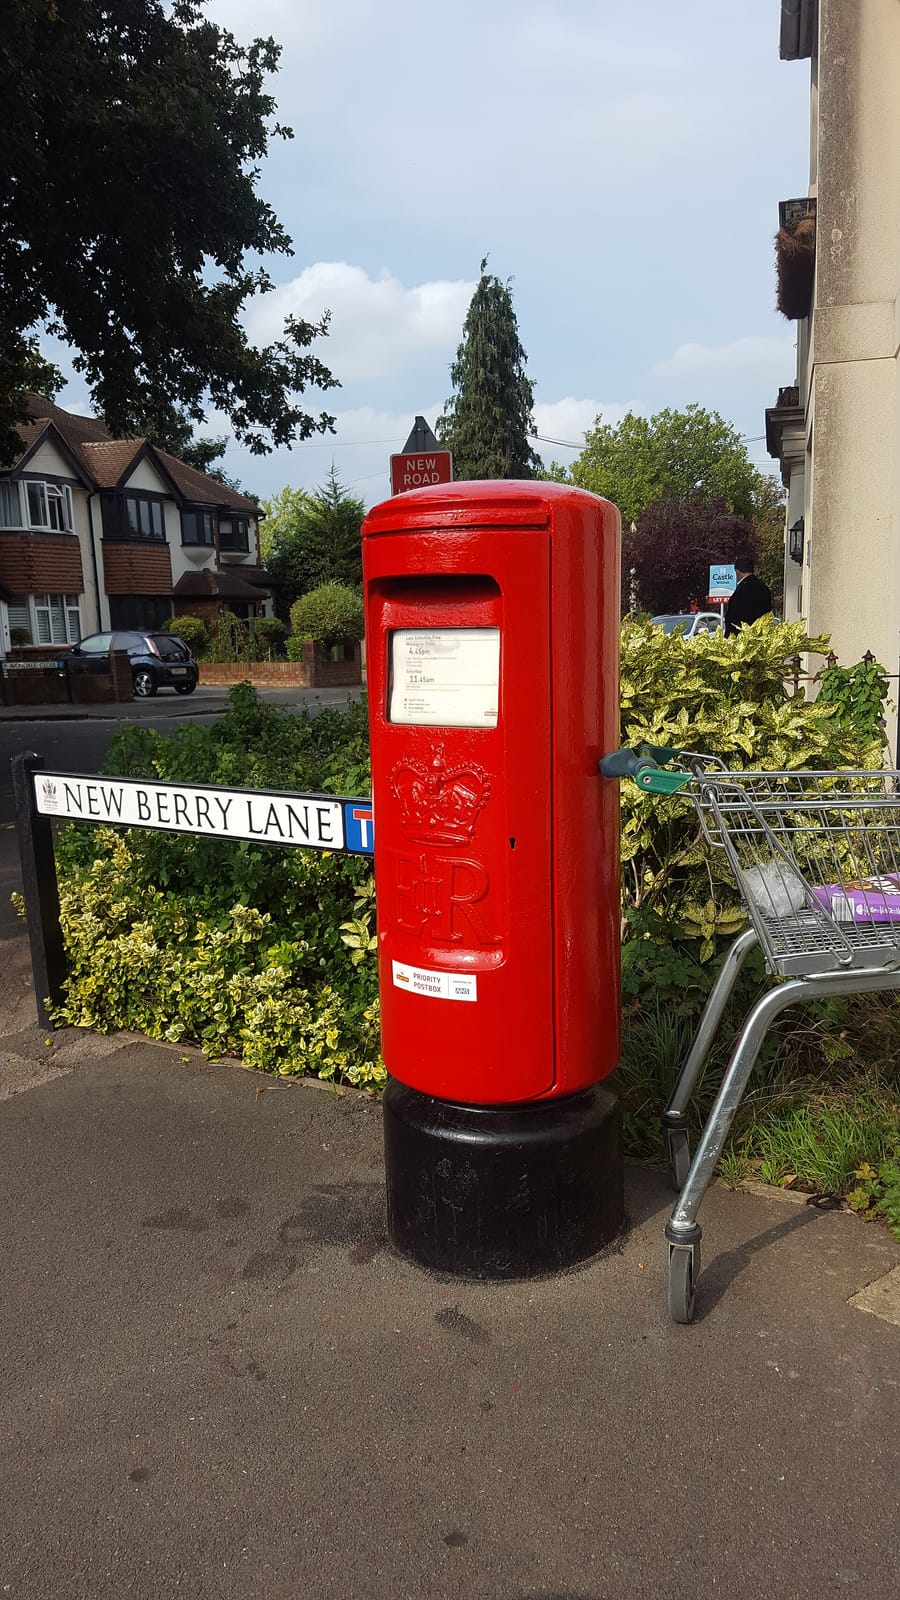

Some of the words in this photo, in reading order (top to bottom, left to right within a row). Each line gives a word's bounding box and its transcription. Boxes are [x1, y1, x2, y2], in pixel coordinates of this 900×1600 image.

[406, 458, 437, 471] NEW
[403, 472, 440, 485] ROAD
[63, 783, 124, 818] NEW
[137, 790, 233, 831] BERRY
[246, 800, 334, 842] LANE
[412, 972, 441, 983] PRIORITY
[413, 981, 442, 993] POSTBOX
